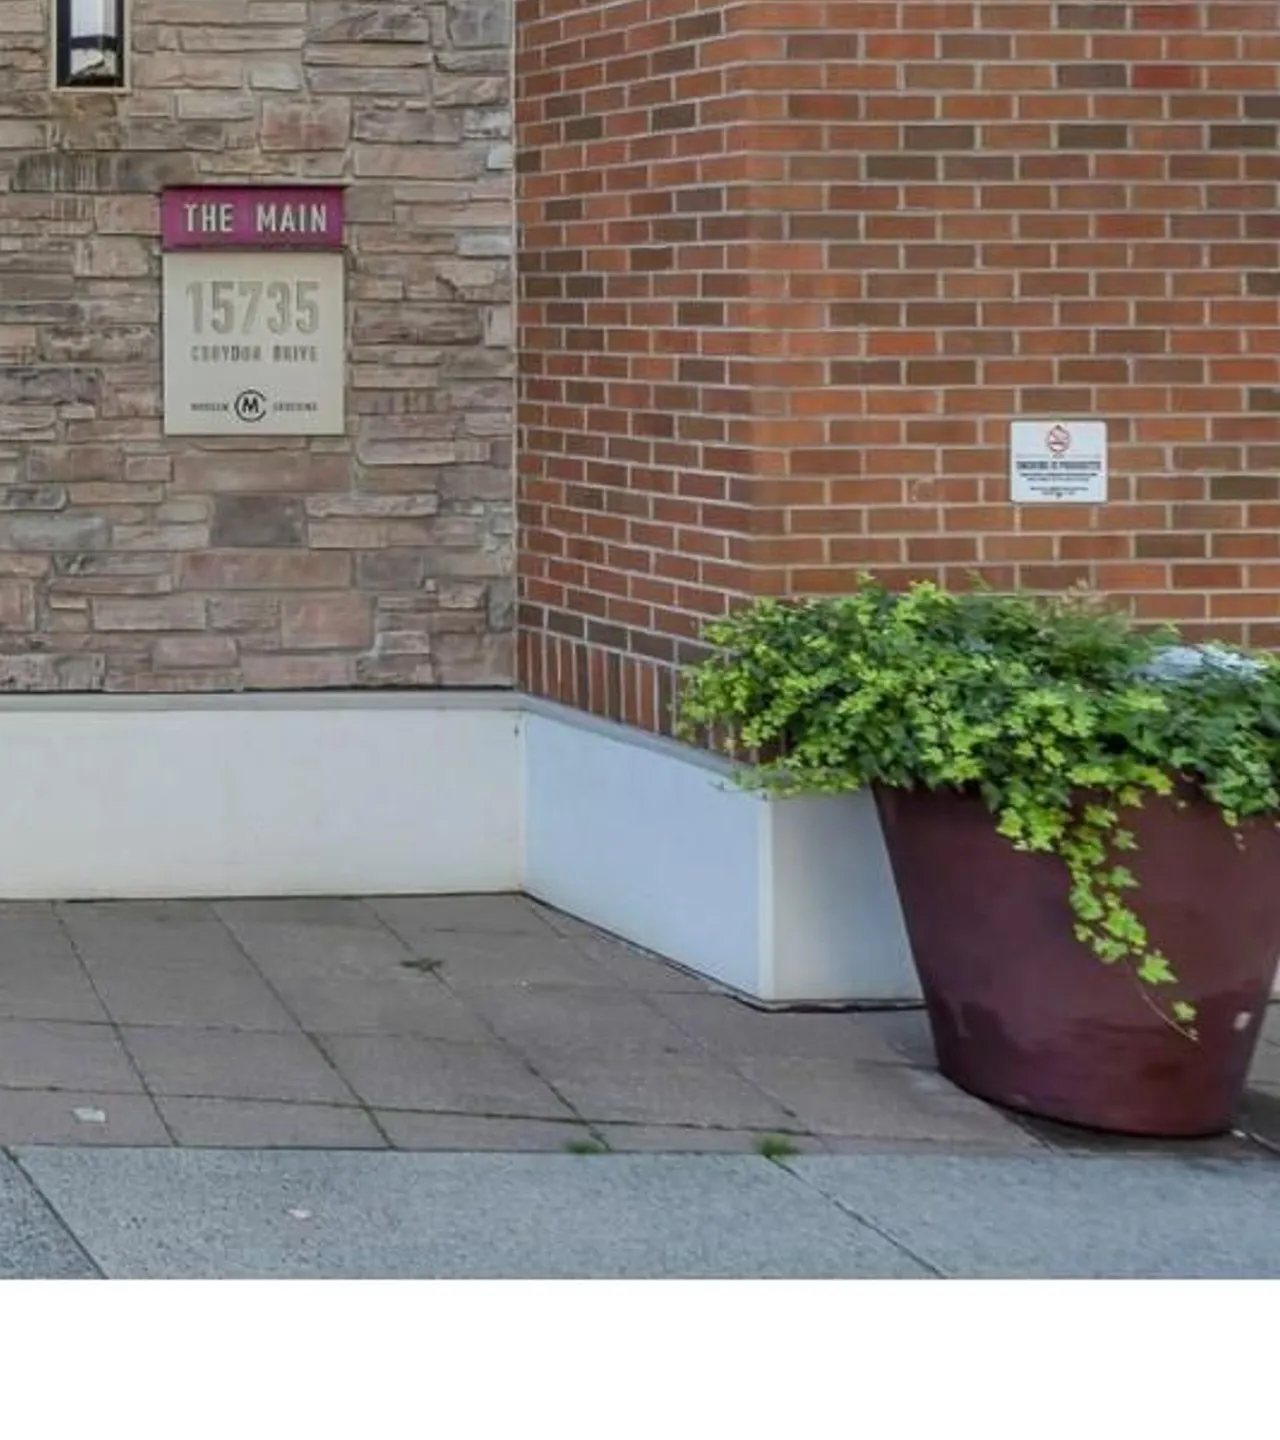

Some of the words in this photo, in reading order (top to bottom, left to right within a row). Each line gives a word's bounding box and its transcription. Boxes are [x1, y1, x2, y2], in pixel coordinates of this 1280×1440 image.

[184, 203, 235, 233] THE
[256, 203, 328, 233] MAIN
[186, 280, 320, 336] 15735
